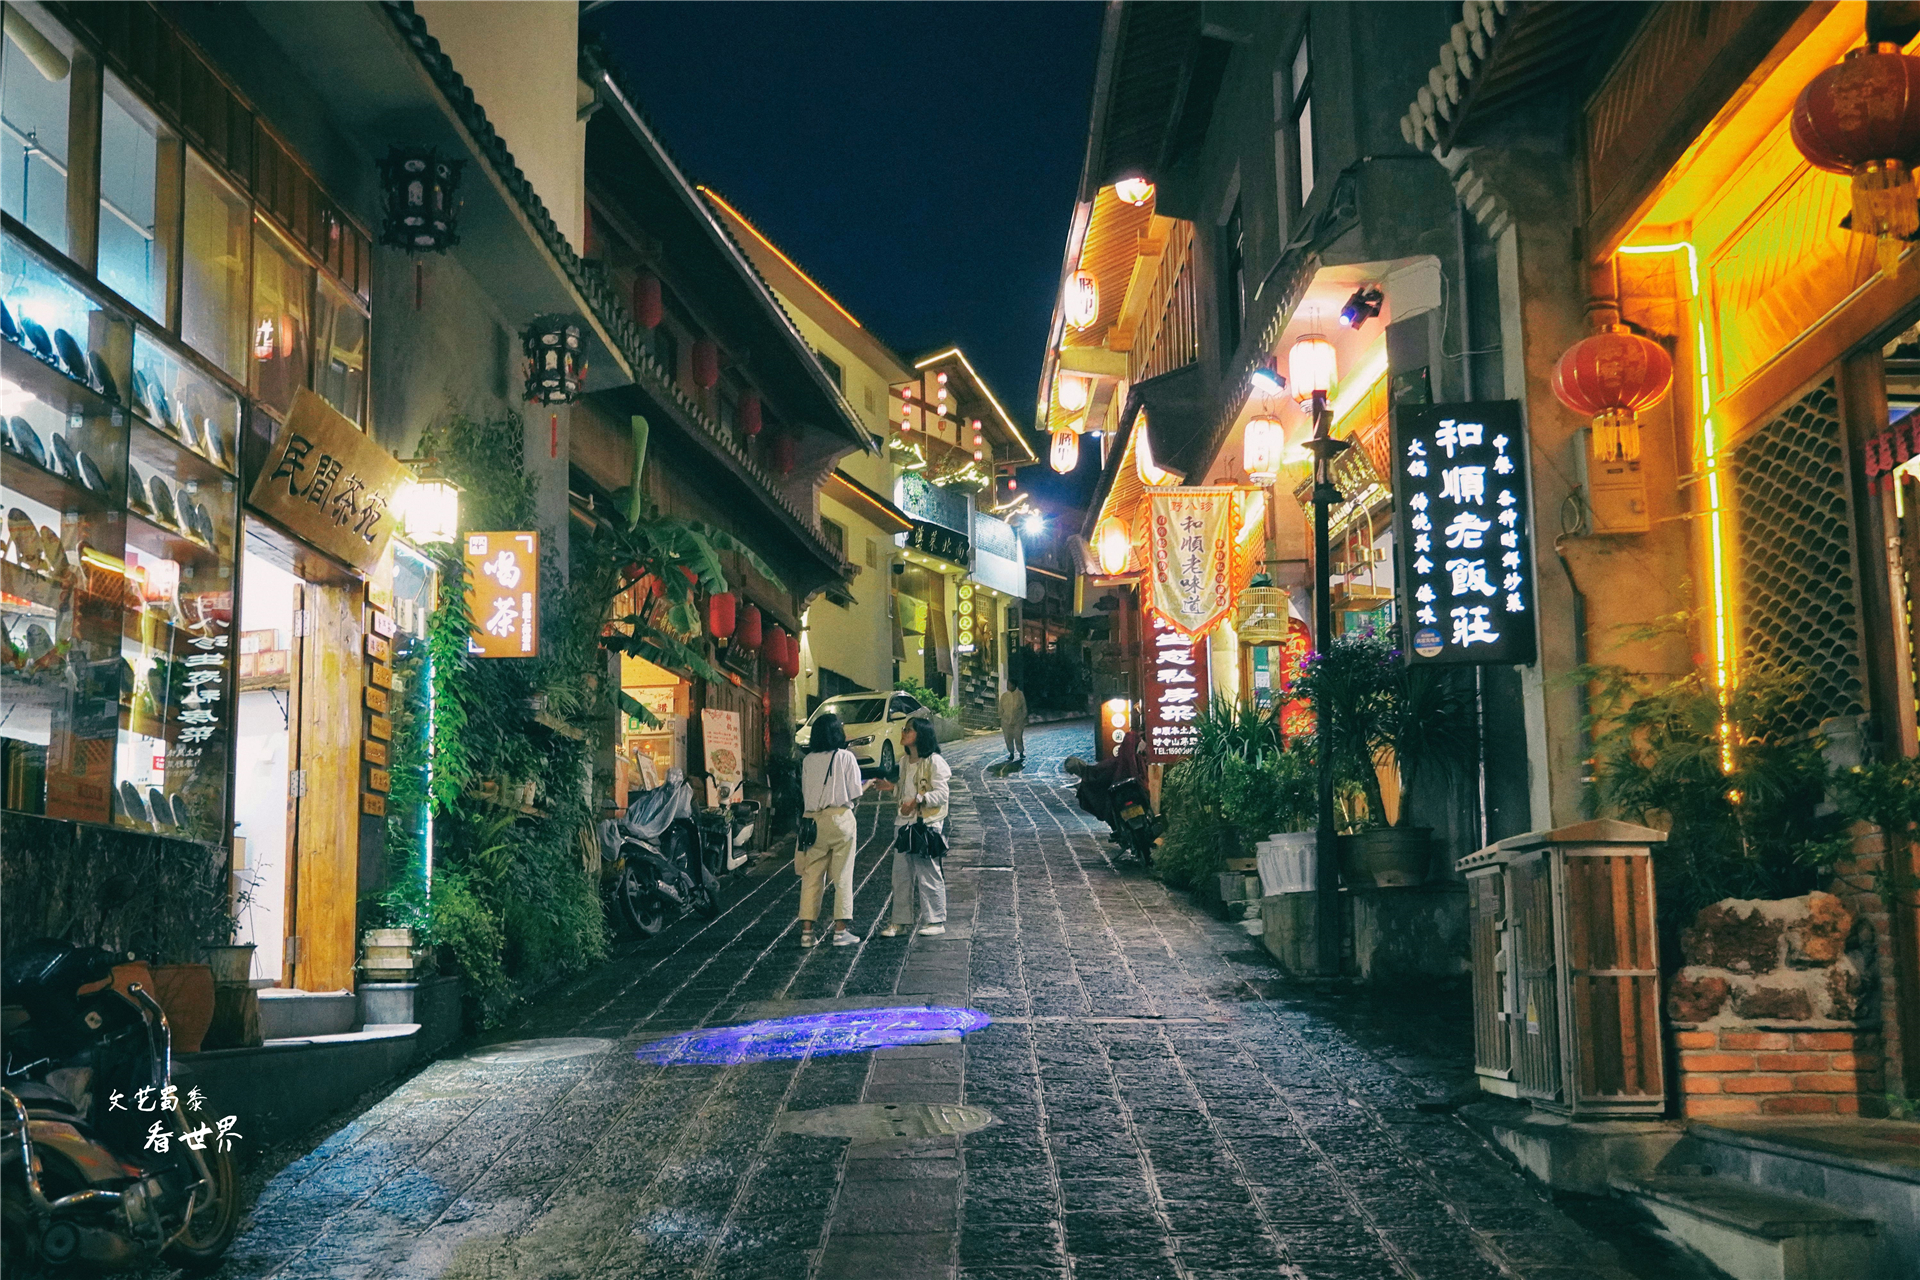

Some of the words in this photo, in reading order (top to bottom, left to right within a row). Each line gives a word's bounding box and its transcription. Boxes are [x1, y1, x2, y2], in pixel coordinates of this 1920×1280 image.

[269, 432, 388, 545] 民間茶苑
[1435, 419, 1501, 648] 和順老飯莊
[483, 550, 521, 638] 喝茶
[1179, 515, 1206, 615] 和順老味道
